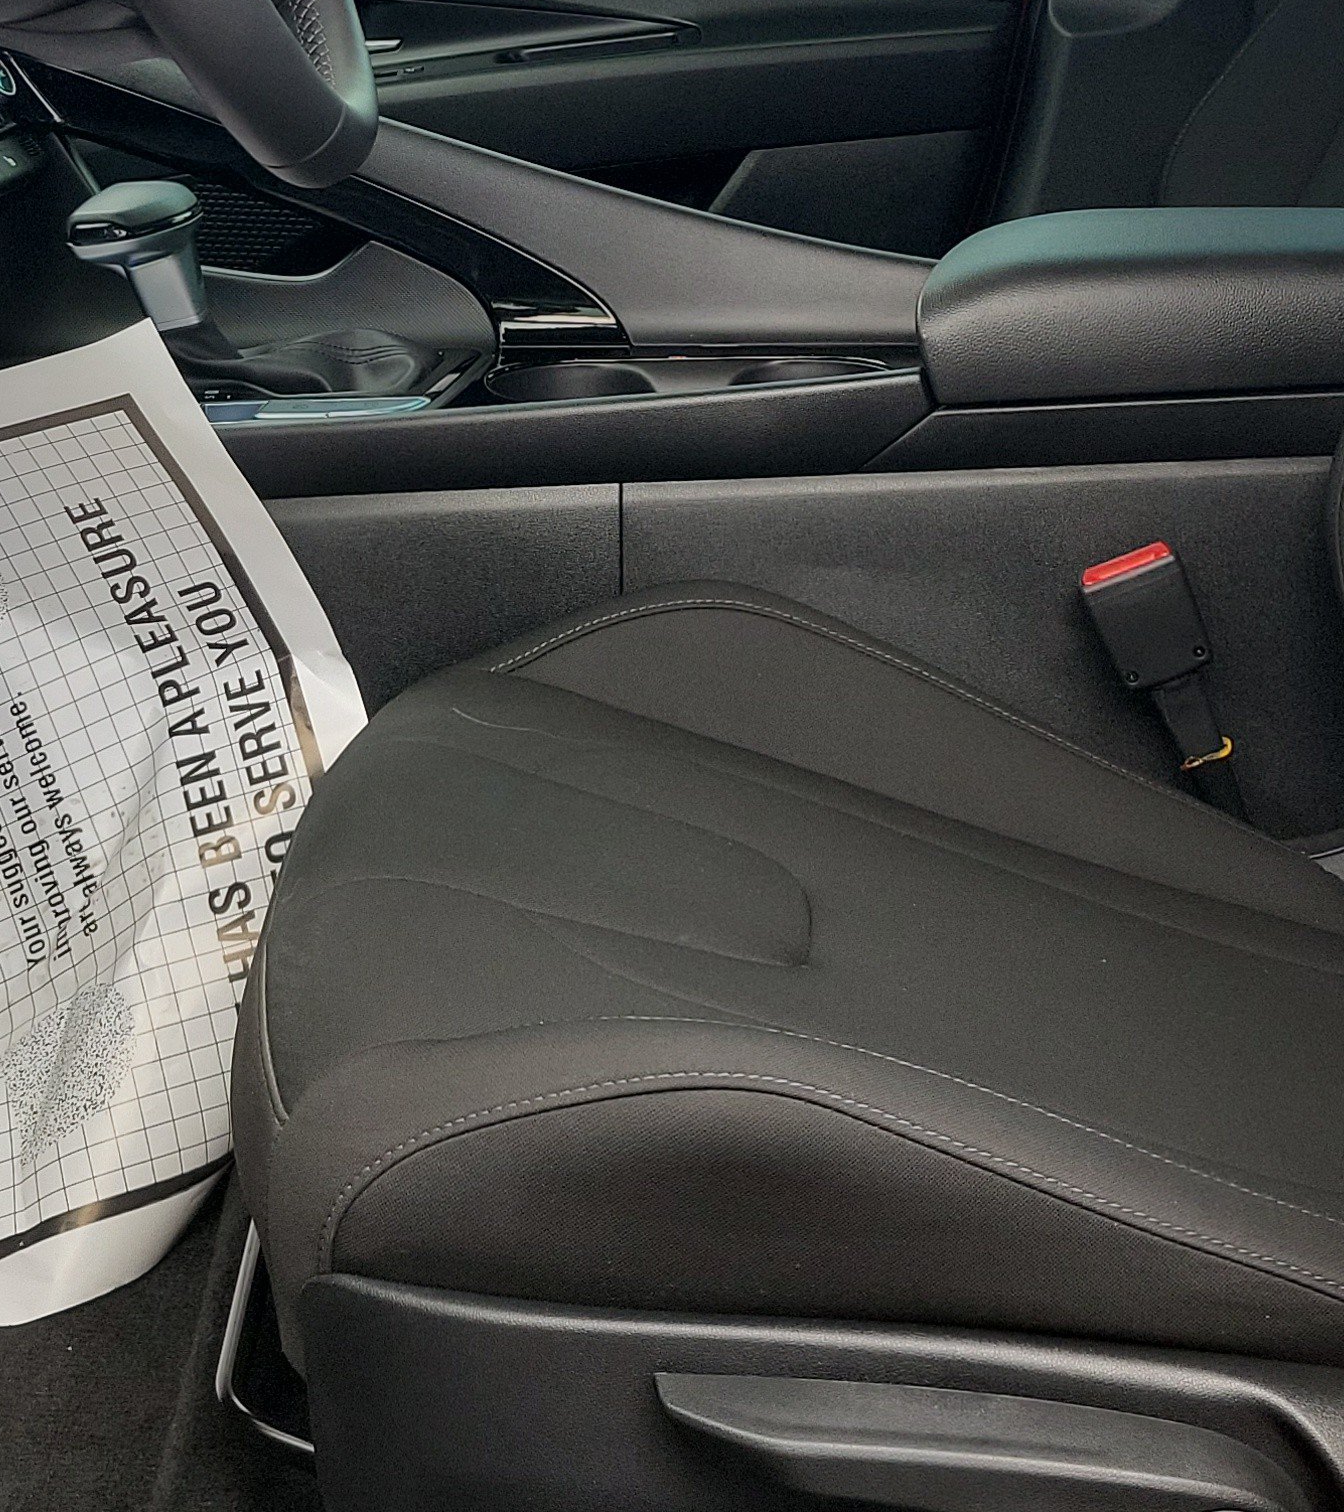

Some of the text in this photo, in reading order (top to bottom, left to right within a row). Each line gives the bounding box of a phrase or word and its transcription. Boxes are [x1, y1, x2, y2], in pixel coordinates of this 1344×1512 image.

[179, 581, 248, 667] YOU
[10, 691, 64, 810] welcome.
[64, 496, 260, 982] HAS BEEN A PLEASURE
[224, 669, 298, 816] SERVE
[9, 795, 37, 835] our
[54, 813, 99, 903] always
[18, 914, 46, 972] Your
